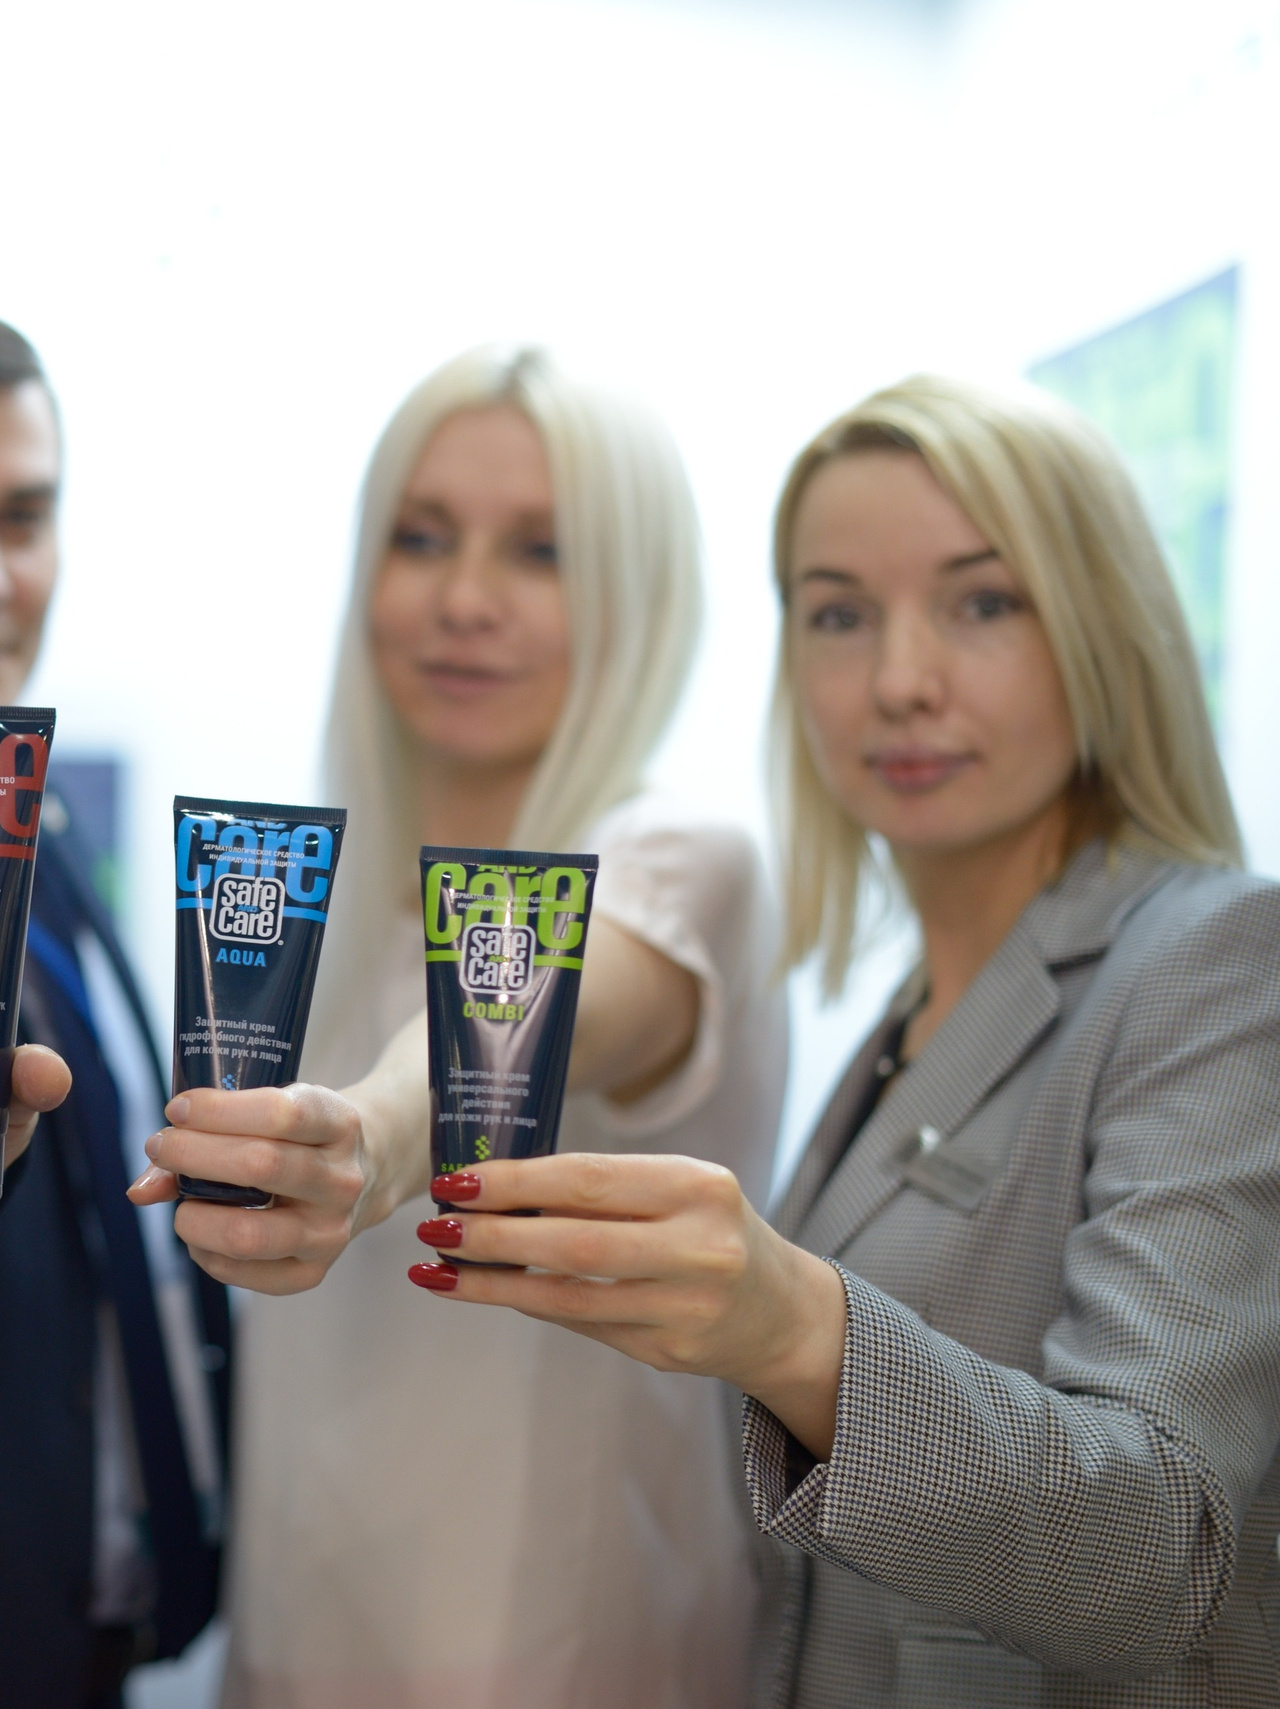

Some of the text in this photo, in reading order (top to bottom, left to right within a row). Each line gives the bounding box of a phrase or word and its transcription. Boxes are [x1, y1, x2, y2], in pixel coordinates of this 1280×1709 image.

[202, 843, 305, 859] ДЕРМАТОЛОГИЧЕСКОЕ СРЕДСТВО
[208, 853, 297, 868] ИНДИВИДУАЛЬНОЙ ЗАЩИТЫ
[237, 904, 259, 913] AND
[215, 947, 267, 967] AQUA
[462, 1001, 525, 1021] COMBI
[195, 1016, 276, 1034] Защитный крем
[246, 1036, 292, 1051] действия
[184, 1046, 200, 1056] для
[231, 1048, 249, 1058] рук
[251, 1050, 258, 1058] и
[259, 1052, 282, 1063] лица
[447, 1084, 530, 1097] универсального
[461, 1097, 511, 1109] действия
[438, 1113, 454, 1123] для
[512, 1116, 537, 1128] лица
